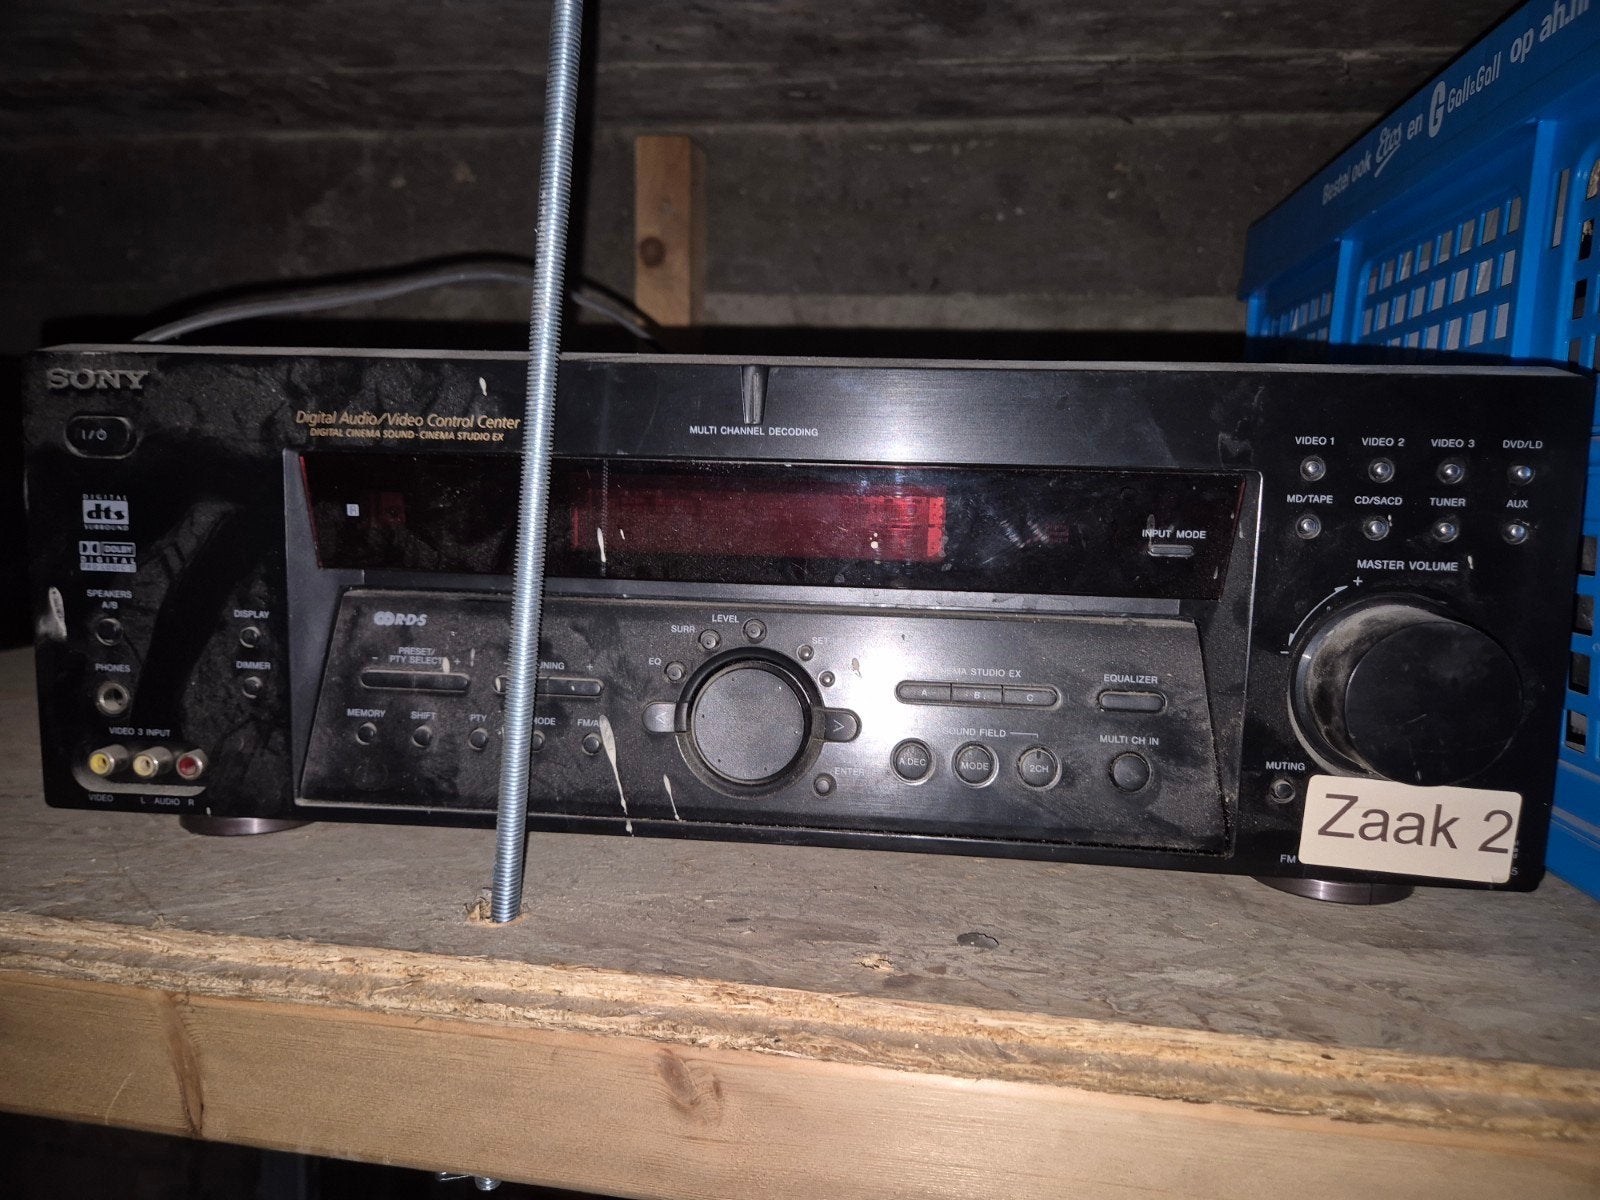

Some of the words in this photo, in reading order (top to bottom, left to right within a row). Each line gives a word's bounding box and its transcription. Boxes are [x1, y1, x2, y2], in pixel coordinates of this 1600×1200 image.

[1352, 150, 1372, 182] ook
[1407, 113, 1423, 140] en
[1510, 28, 1534, 64] op
[47, 368, 149, 390] SONY
[295, 410, 337, 427] Digital
[339, 410, 424, 426] Audio/Video
[427, 413, 475, 428] Control
[477, 414, 521, 429] Center
[310, 427, 343, 438] DIGITAL
[345, 428, 380, 438] CINEMA
[457, 431, 491, 441] STUDIO
[492, 432, 504, 442] EX
[689, 425, 717, 434] MULTI
[720, 426, 765, 435] CHANNEL
[768, 427, 819, 437] DECODING
[1295, 436, 1327, 446] VIDEO
[1330, 436, 1336, 446] 1
[1361, 437, 1394, 447] VIDEO
[1397, 437, 1406, 447] 2
[1430, 438, 1465, 448] VIDEO
[1467, 439, 1476, 448] 3
[1502, 439, 1543, 449] DVD/LD
[1286, 494, 1333, 504] MD/TAPE
[1354, 496, 1403, 506] CD/SACD
[1429, 498, 1466, 507] TUNER
[1506, 499, 1528, 509] AUX
[87, 503, 126, 520] dts
[1141, 529, 1172, 538] INPUT
[1176, 530, 1207, 539] MODE
[80, 555, 136, 564] DIGITAL
[1356, 559, 1405, 571] MASTER
[1409, 560, 1458, 571] VOLUME
[86, 589, 132, 599] SPEAKERS
[101, 601, 118, 610] A/B
[233, 609, 270, 619] DISPLAY
[711, 614, 740, 624] LEVEL
[670, 625, 695, 633] SURR
[398, 647, 436, 656] PRESET/
[389, 655, 407, 663] PTY
[409, 656, 444, 665] SELECT
[648, 657, 661, 667] EQ
[95, 663, 130, 673] PHONES
[236, 661, 271, 670] DIMMER
[538, 662, 565, 670] NING
[970, 668, 1005, 677] STUDIO
[1008, 669, 1022, 678] EX
[1103, 673, 1158, 684] EQUALIZER
[921, 688, 928, 697] A
[973, 691, 981, 699] B
[1026, 693, 1034, 701] C
[347, 708, 386, 718] MEMORY
[410, 711, 437, 720] SHIFT
[470, 714, 487, 722] PTY
[577, 718, 601, 727] FM/A
[109, 727, 135, 736] VIDEO
[137, 727, 143, 737] 3
[146, 728, 170, 737] INPUT
[942, 727, 976, 737] SOUND
[979, 728, 1007, 738] FIELD
[1100, 735, 1128, 745] MULTI
[1132, 735, 1146, 745] CH
[1149, 736, 1159, 746] IN
[961, 762, 989, 771] MODE
[1029, 764, 1049, 773] 2CH
[1265, 761, 1305, 771] MUTING
[88, 793, 114, 803] VIDEO
[154, 797, 180, 806] AUDIO
[188, 798, 194, 807] R
[1317, 793, 1460, 849] Zaak
[1478, 809, 1513, 854] 2
[1280, 854, 1296, 864] FM
